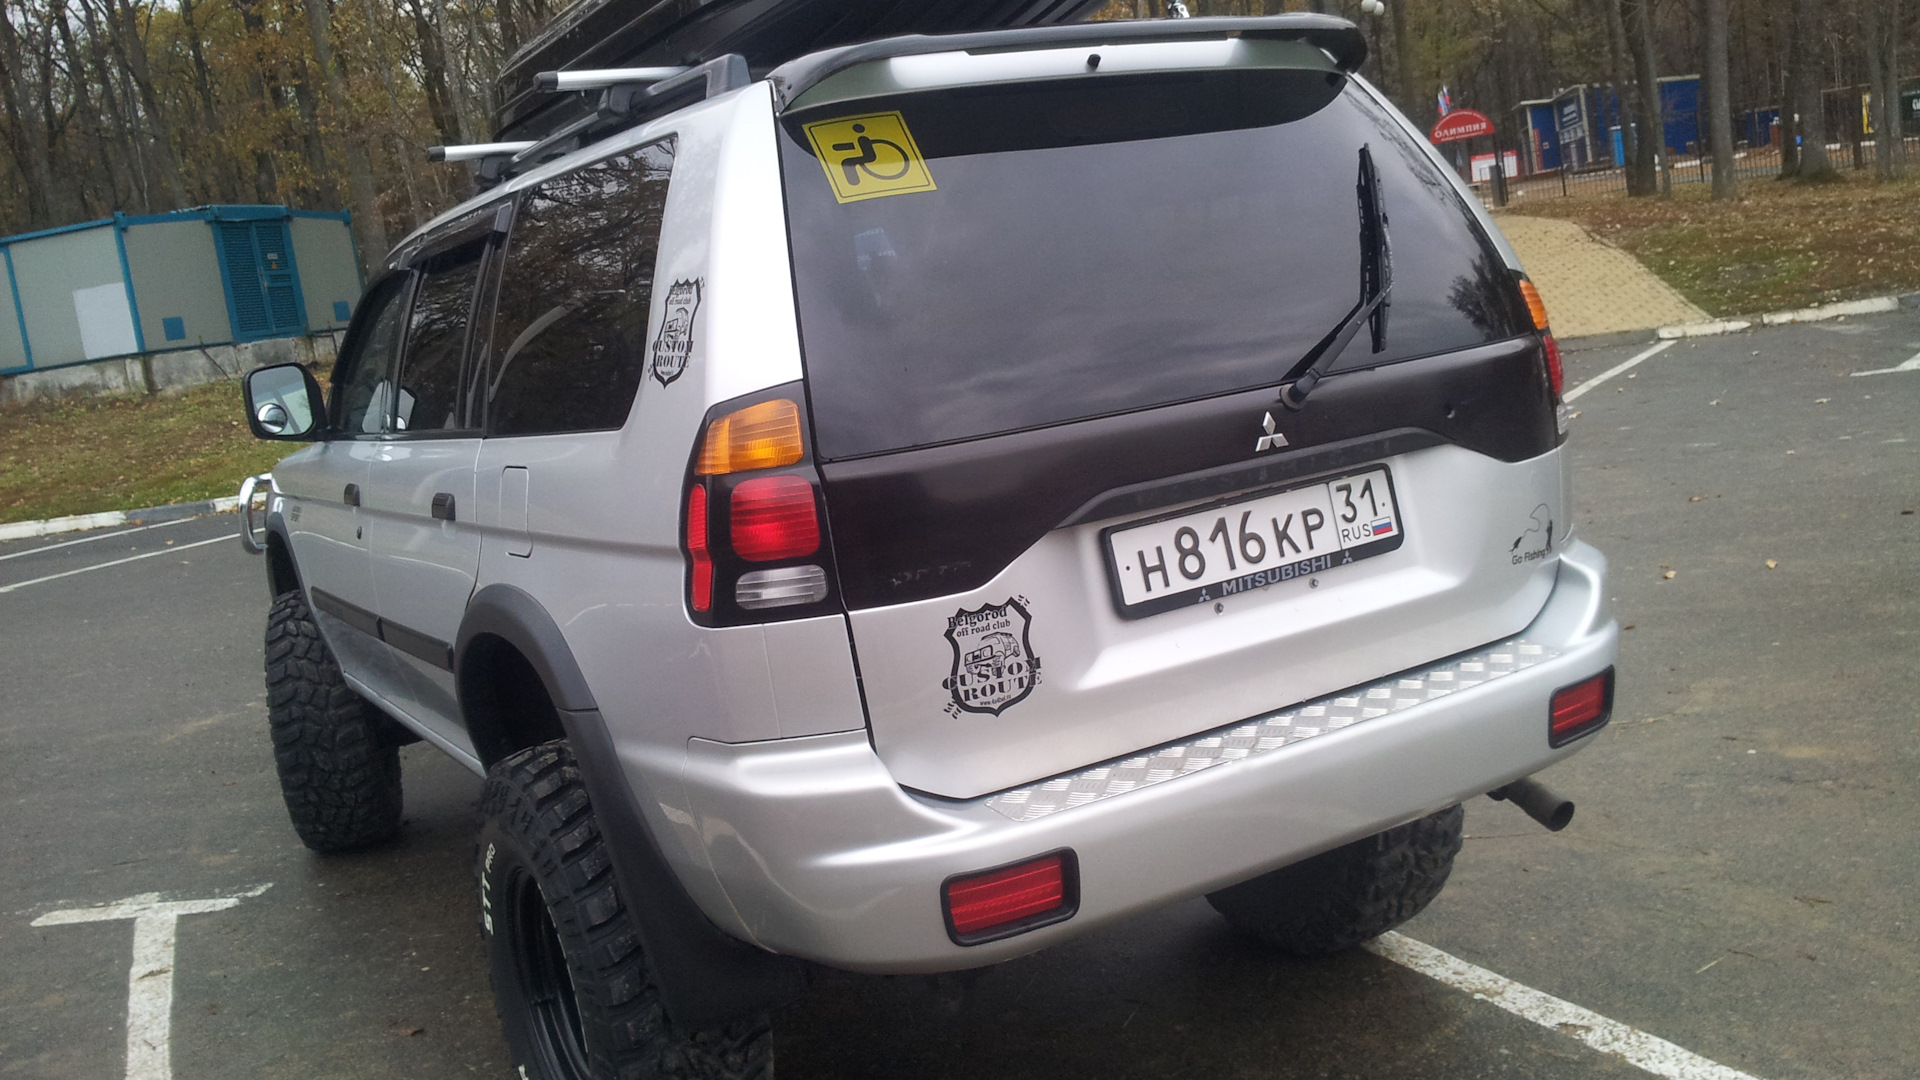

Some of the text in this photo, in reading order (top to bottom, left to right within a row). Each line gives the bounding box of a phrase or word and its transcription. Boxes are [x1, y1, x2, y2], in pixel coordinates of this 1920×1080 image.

[1434, 122, 1487, 138] ОЛИМПИЯ
[652, 340, 694, 353] CUSTOM
[656, 355, 691, 368] ROUTE
[1336, 478, 1378, 523] 31
[1341, 523, 1372, 543] RUS
[1138, 508, 1325, 592] H816KP
[1511, 555, 1523, 565] Go
[1222, 555, 1332, 595] MITSUBISHI
[947, 606, 1008, 629] Belgorod
[956, 618, 1011, 638] off road club
[942, 656, 1042, 690] CUSTOM
[963, 672, 1042, 702] ROUTE
[481, 842, 496, 935] STT PRO
